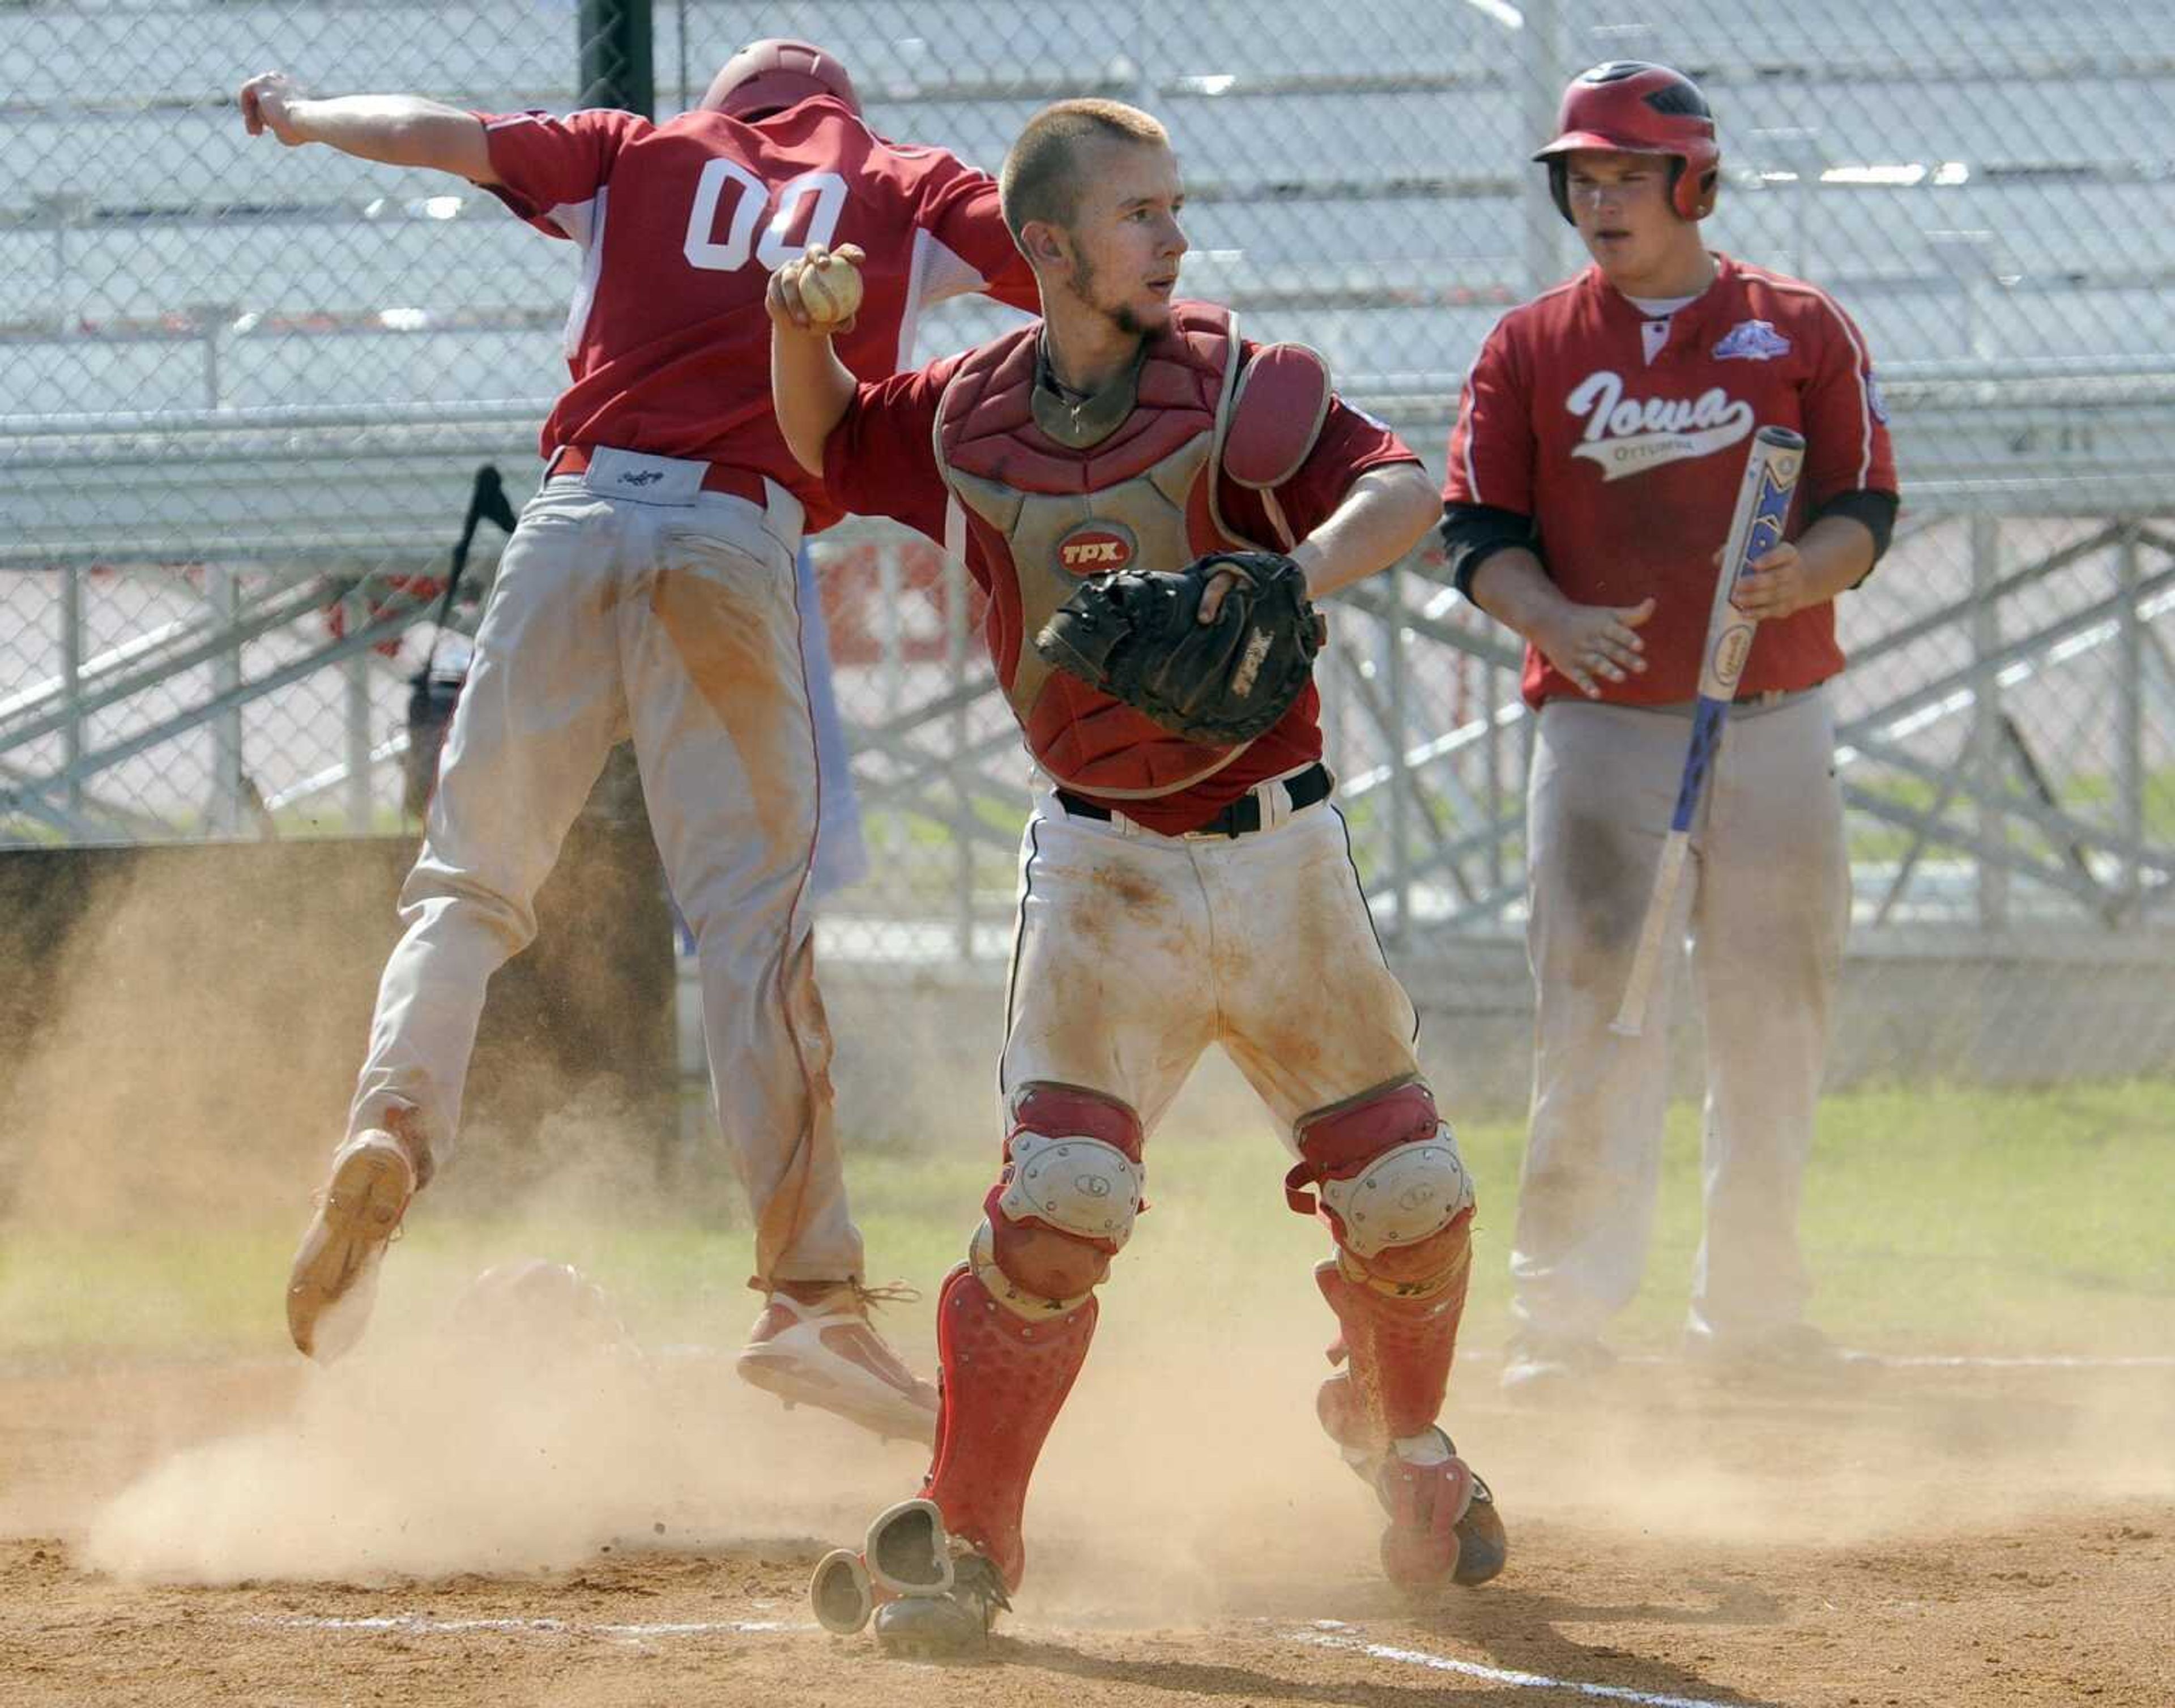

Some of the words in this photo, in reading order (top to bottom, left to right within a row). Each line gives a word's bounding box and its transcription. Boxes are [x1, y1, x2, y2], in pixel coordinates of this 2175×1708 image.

[684, 157, 848, 272] 00
[1567, 371, 1735, 442] Iowa
[1063, 542, 1119, 563] TPX
